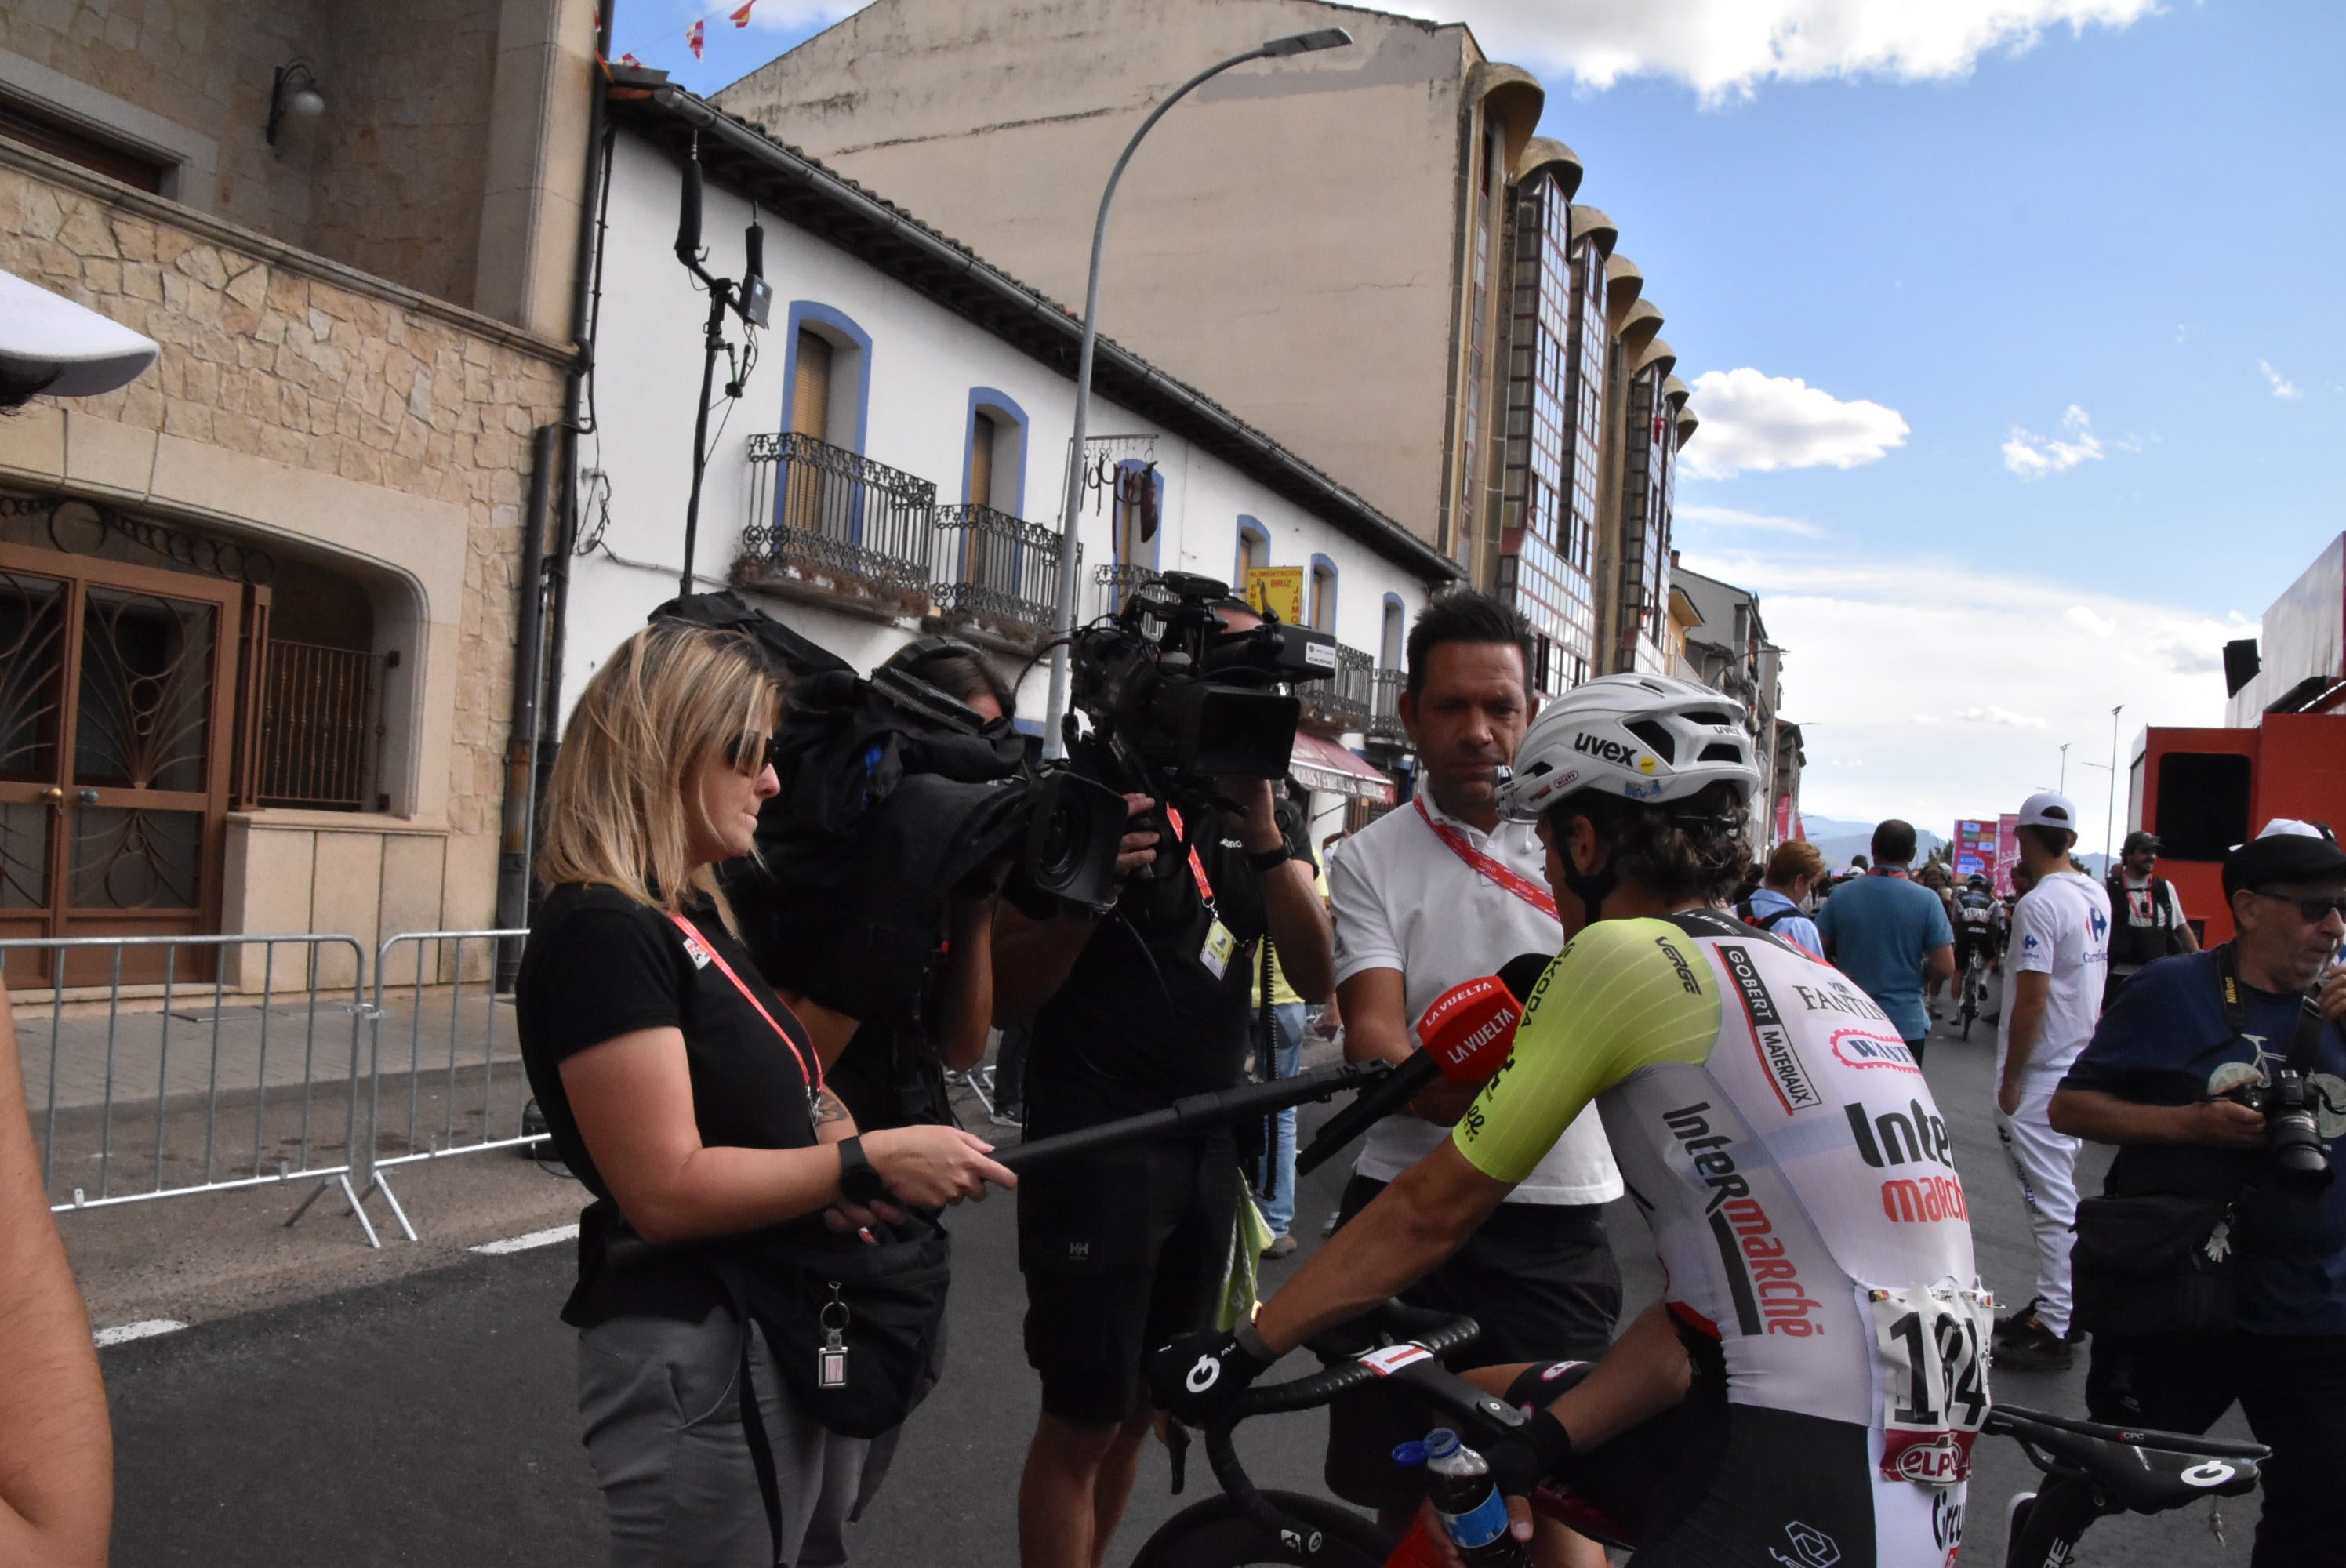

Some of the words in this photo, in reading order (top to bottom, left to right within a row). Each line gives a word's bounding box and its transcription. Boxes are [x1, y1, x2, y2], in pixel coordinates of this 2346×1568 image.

[1270, 579, 1292, 588] BRIZ
[1574, 732, 1639, 768] uvex
[1727, 949, 1774, 1019] GOBERT
[2225, 976, 2237, 1004] Nikon
[1425, 1011, 1440, 1028] LA
[1441, 982, 1493, 1012] VUELTA
[1447, 1044, 1465, 1064] LA
[1463, 1007, 1516, 1053] VUELTA
[1847, 1040, 1916, 1065] WANT
[1763, 1031, 1813, 1105] MATERIAUX
[2123, 1432, 2145, 1441] CPC
